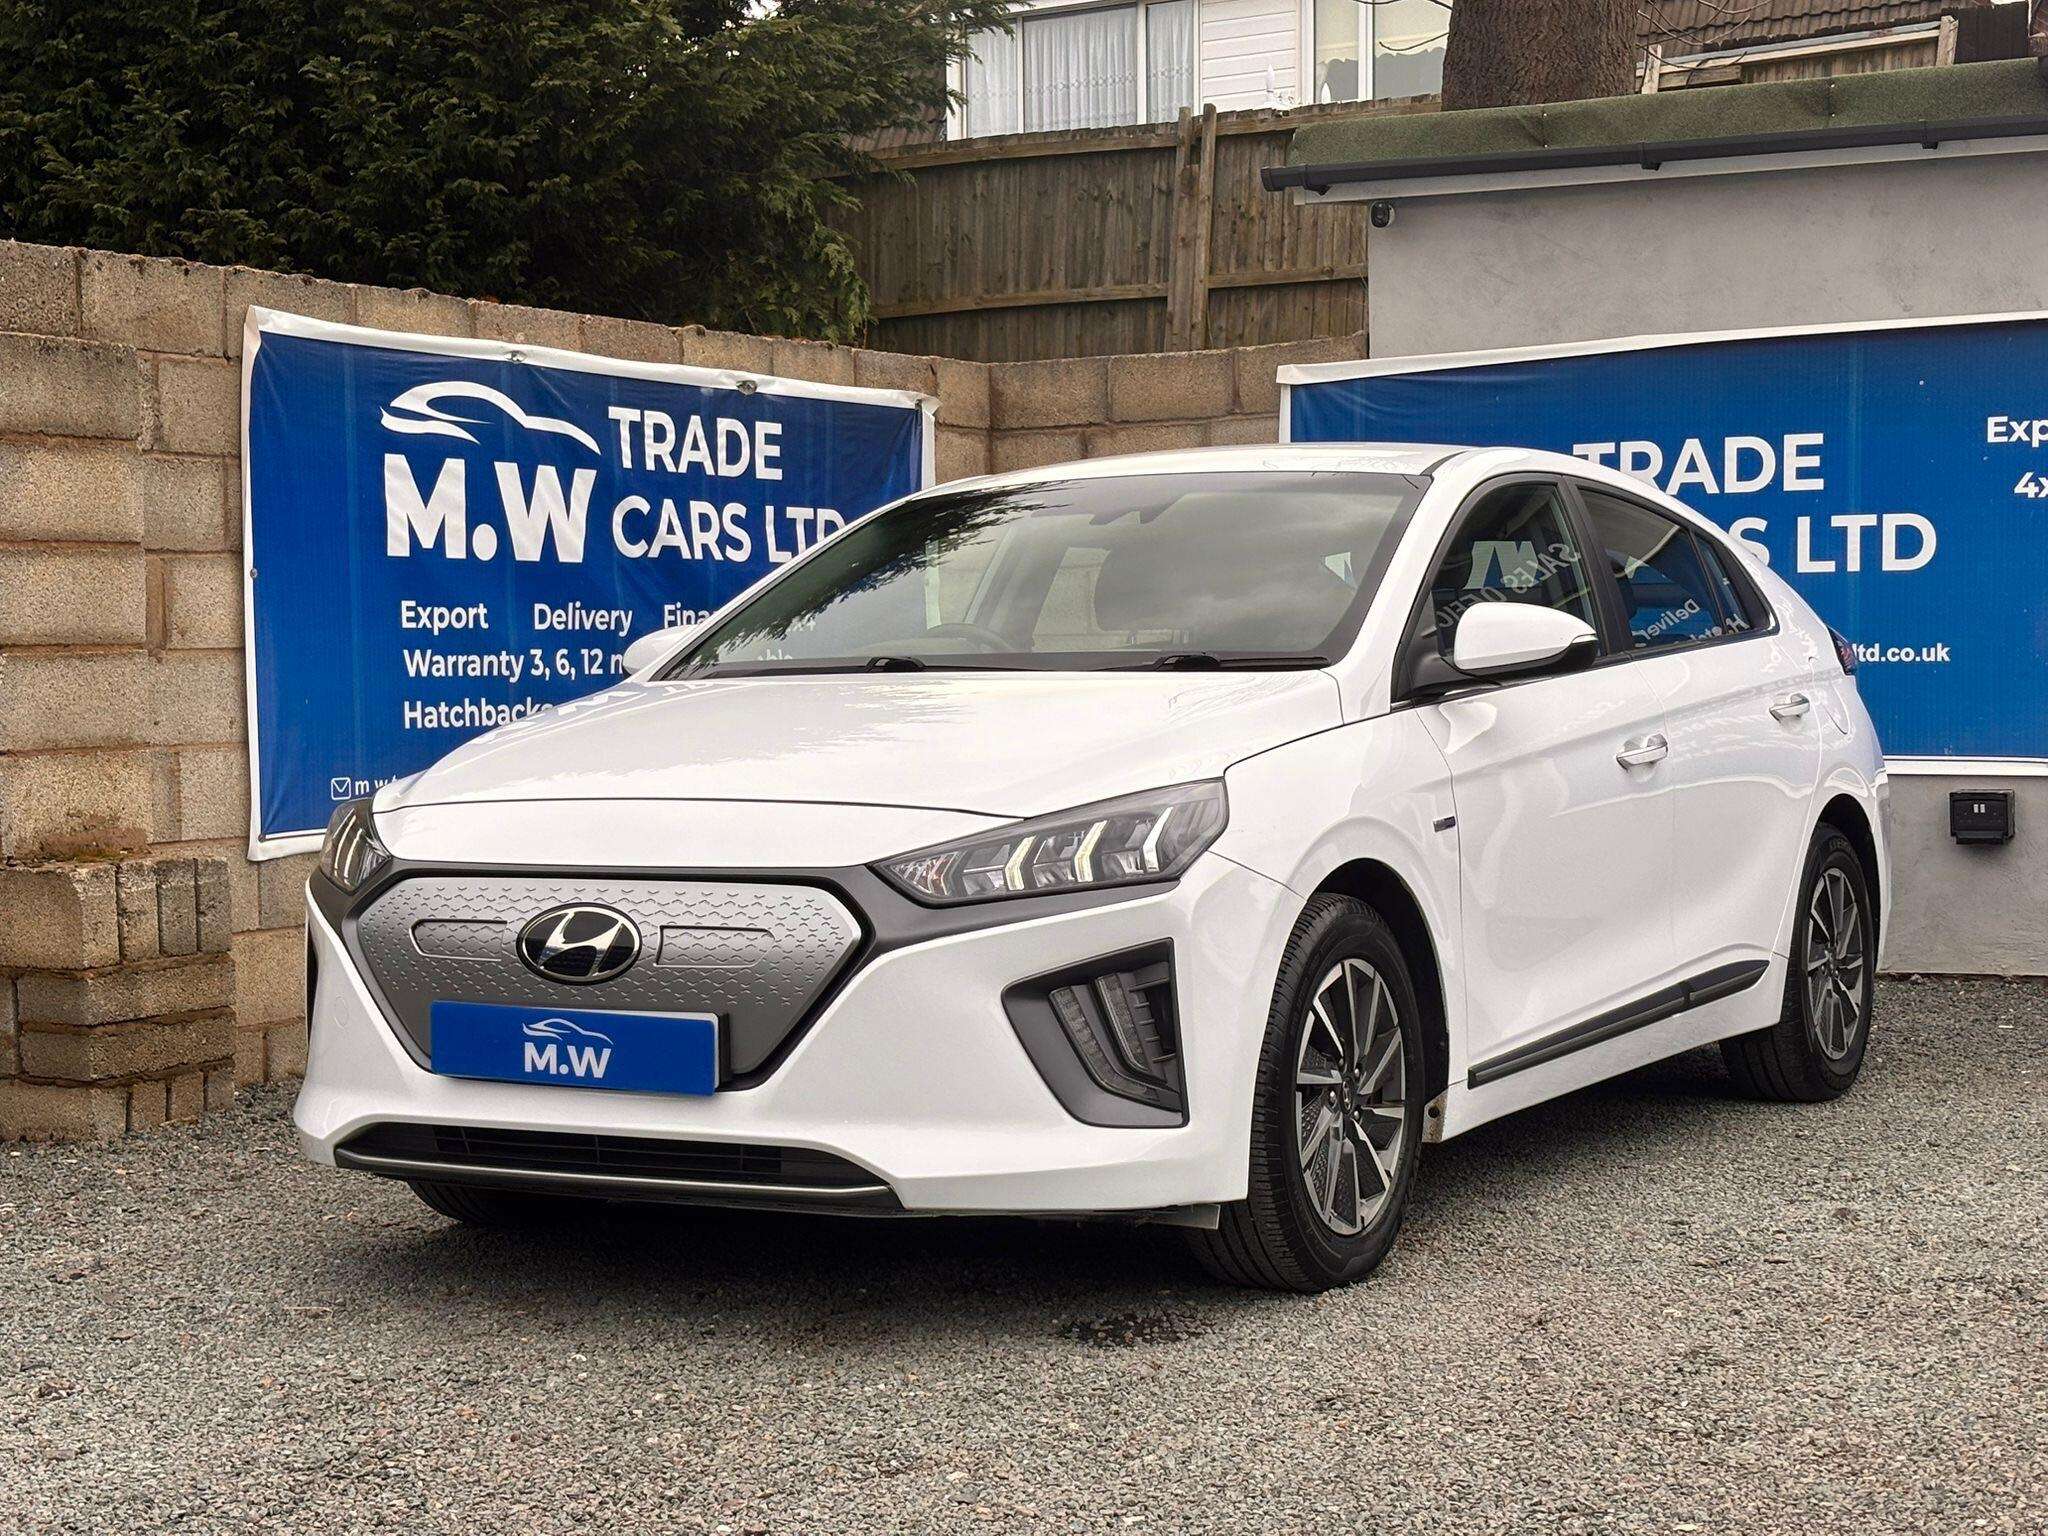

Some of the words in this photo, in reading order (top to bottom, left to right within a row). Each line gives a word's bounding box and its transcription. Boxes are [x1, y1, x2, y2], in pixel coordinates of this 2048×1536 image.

[608, 406, 783, 481] TRADE
[1987, 416, 2048, 448] Exp
[1572, 432, 1825, 496] TRADE
[384, 452, 598, 563] M.W
[612, 495, 752, 563] CARS
[766, 504, 846, 563] LTD
[1797, 513, 1937, 573] LTD
[401, 600, 489, 636] Export
[534, 601, 633, 637] Delivery
[664, 603, 714, 630] Fina
[403, 648, 525, 683] Warranty
[530, 648, 550, 681] 3,
[555, 648, 576, 681] 6,
[581, 648, 604, 675] 12
[1851, 642, 1951, 662] ltd.co.uk
[524, 1042, 612, 1079] M.W
